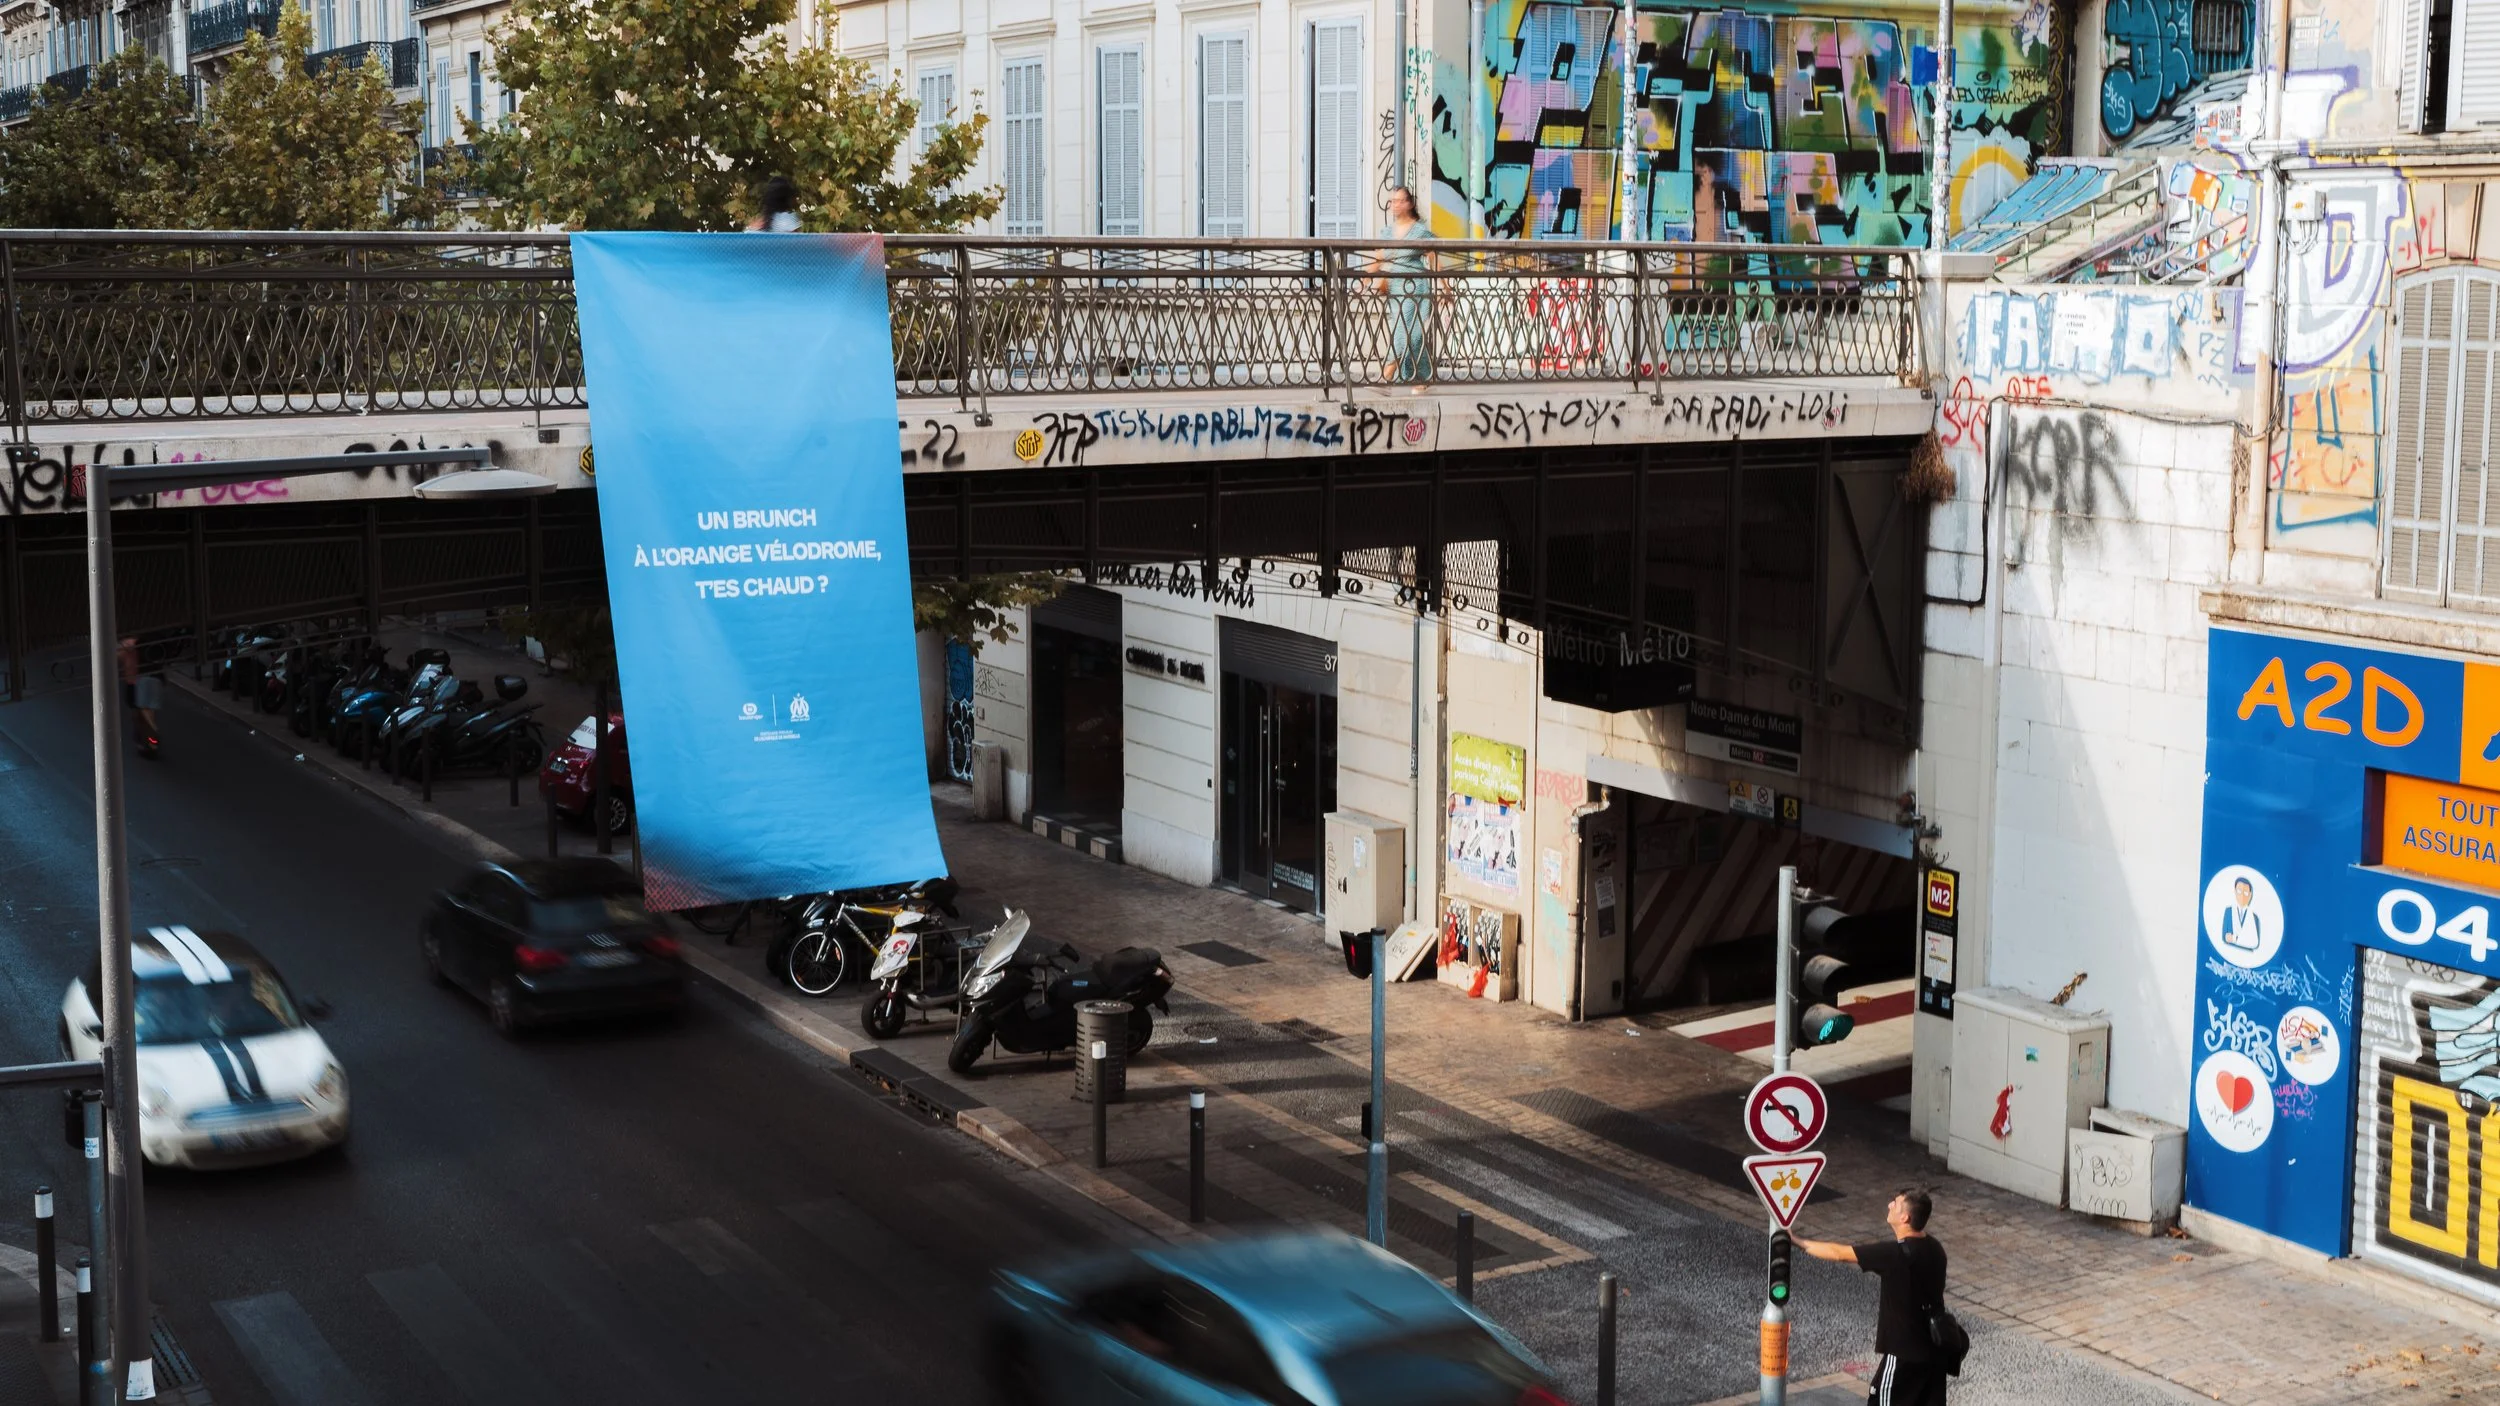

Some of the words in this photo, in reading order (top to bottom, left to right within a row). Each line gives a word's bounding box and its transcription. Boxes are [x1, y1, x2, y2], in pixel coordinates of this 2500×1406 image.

[1015, 430, 1042, 458] STUP
[697, 511, 729, 531] UN
[732, 508, 817, 529] BRUNCH
[634, 544, 651, 567] À
[652, 543, 752, 567] L'ORANGE
[755, 539, 882, 563] VÉLODROME,
[695, 578, 741, 600] T'ES
[743, 575, 815, 597] CHAUD
[819, 575, 829, 594] ?
[1620, 627, 1690, 668] Métro
[1324, 654, 1338, 673] 37
[2238, 656, 2425, 748] A2D
[1690, 700, 1717, 720] Notre
[1719, 706, 1747, 725] Dame
[1751, 712, 1766, 728] du
[1768, 717, 1797, 736] Mont
[1454, 769, 1479, 786] parking
[2402, 825, 2500, 866] ASSURA
[1931, 885, 1951, 908] M2
[2377, 888, 2499, 963] 04
